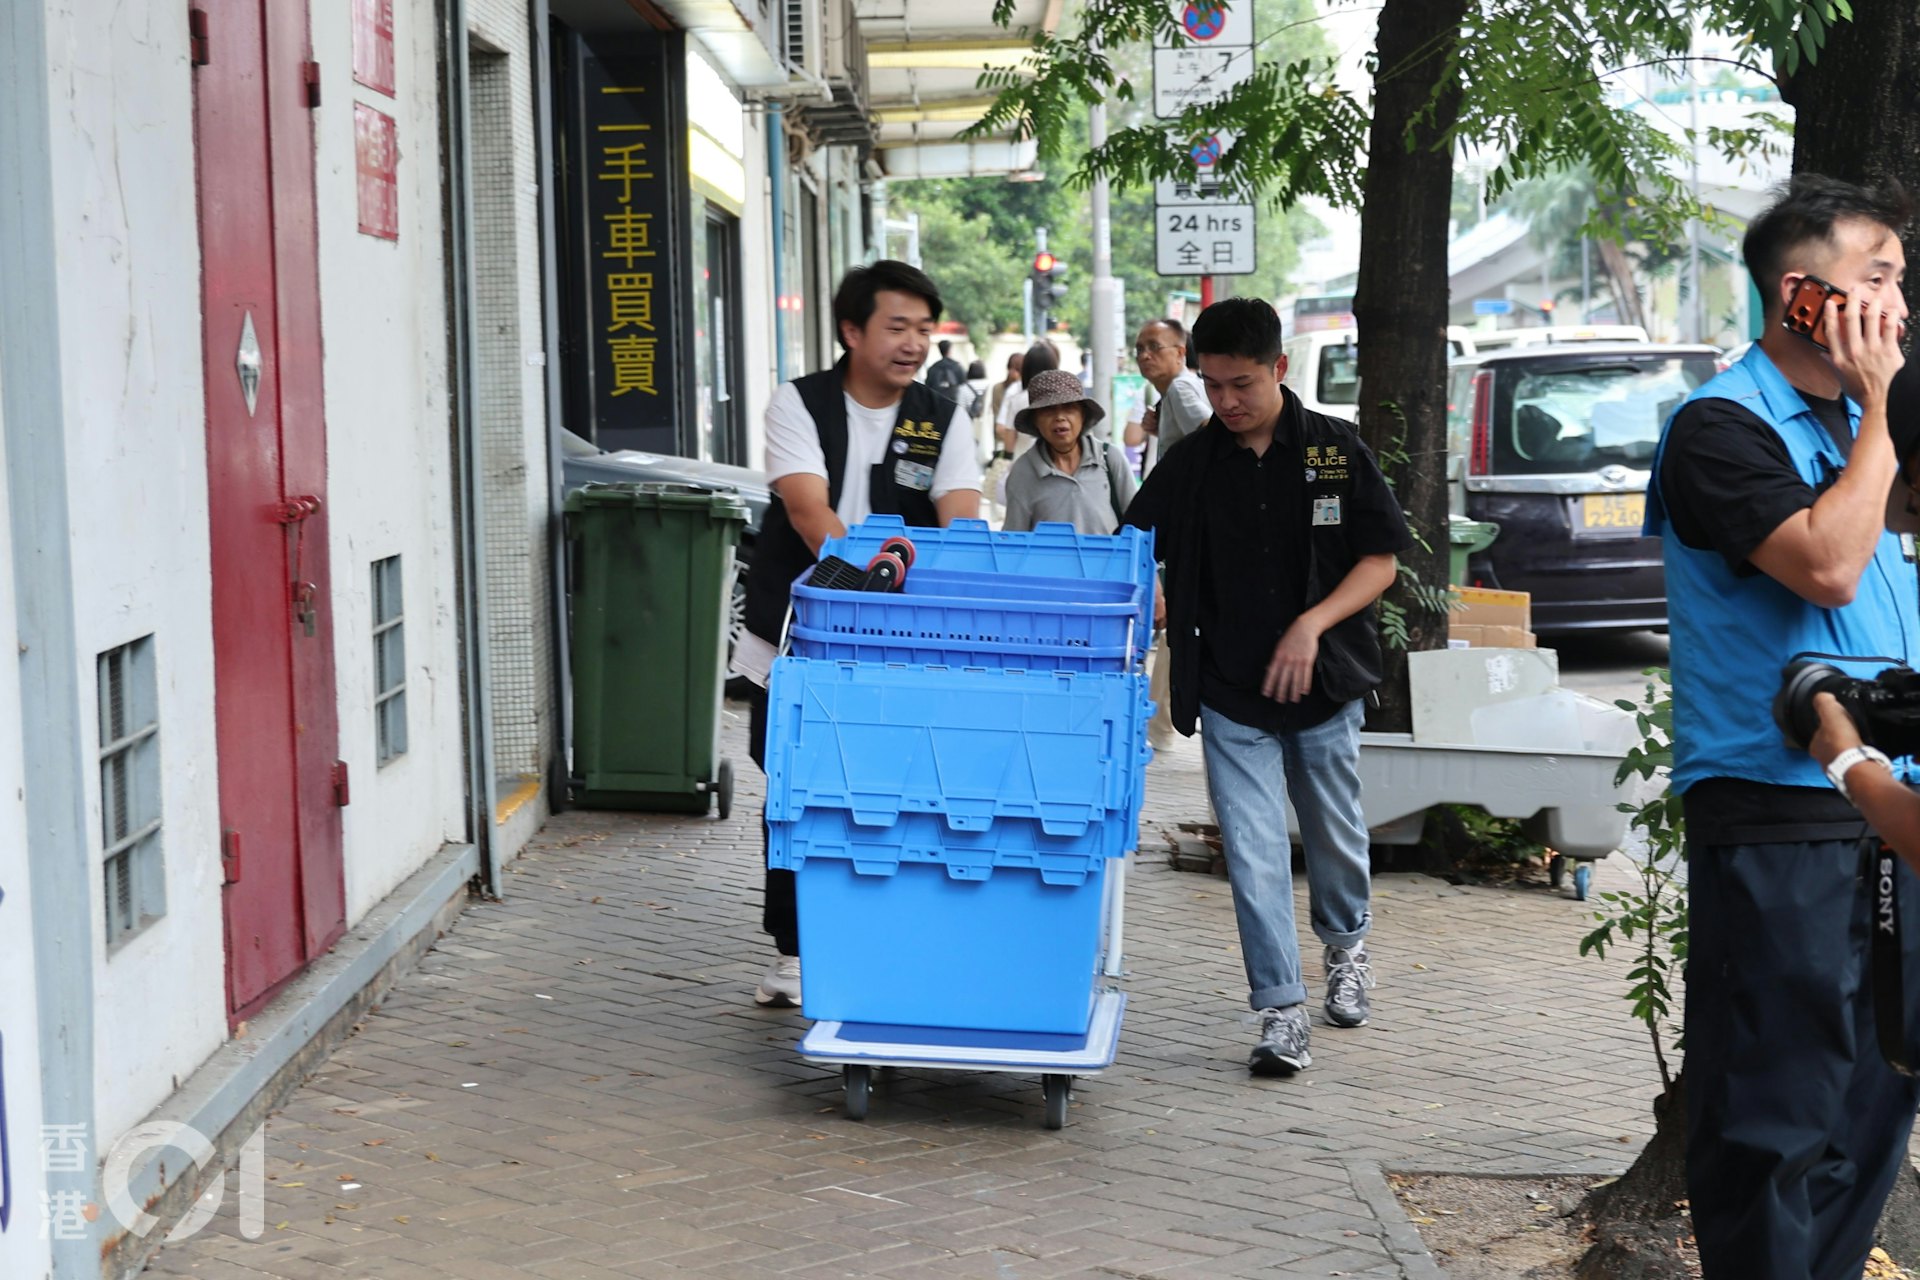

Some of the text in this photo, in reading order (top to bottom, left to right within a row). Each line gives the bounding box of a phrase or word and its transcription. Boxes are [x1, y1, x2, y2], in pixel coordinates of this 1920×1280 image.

[1218, 52, 1233, 73] 7
[1169, 215, 1242, 232] 24 hrs
[598, 86, 658, 396] 二手車買賣
[1177, 241, 1233, 265] 全日
[1880, 858, 1894, 935] SONY
